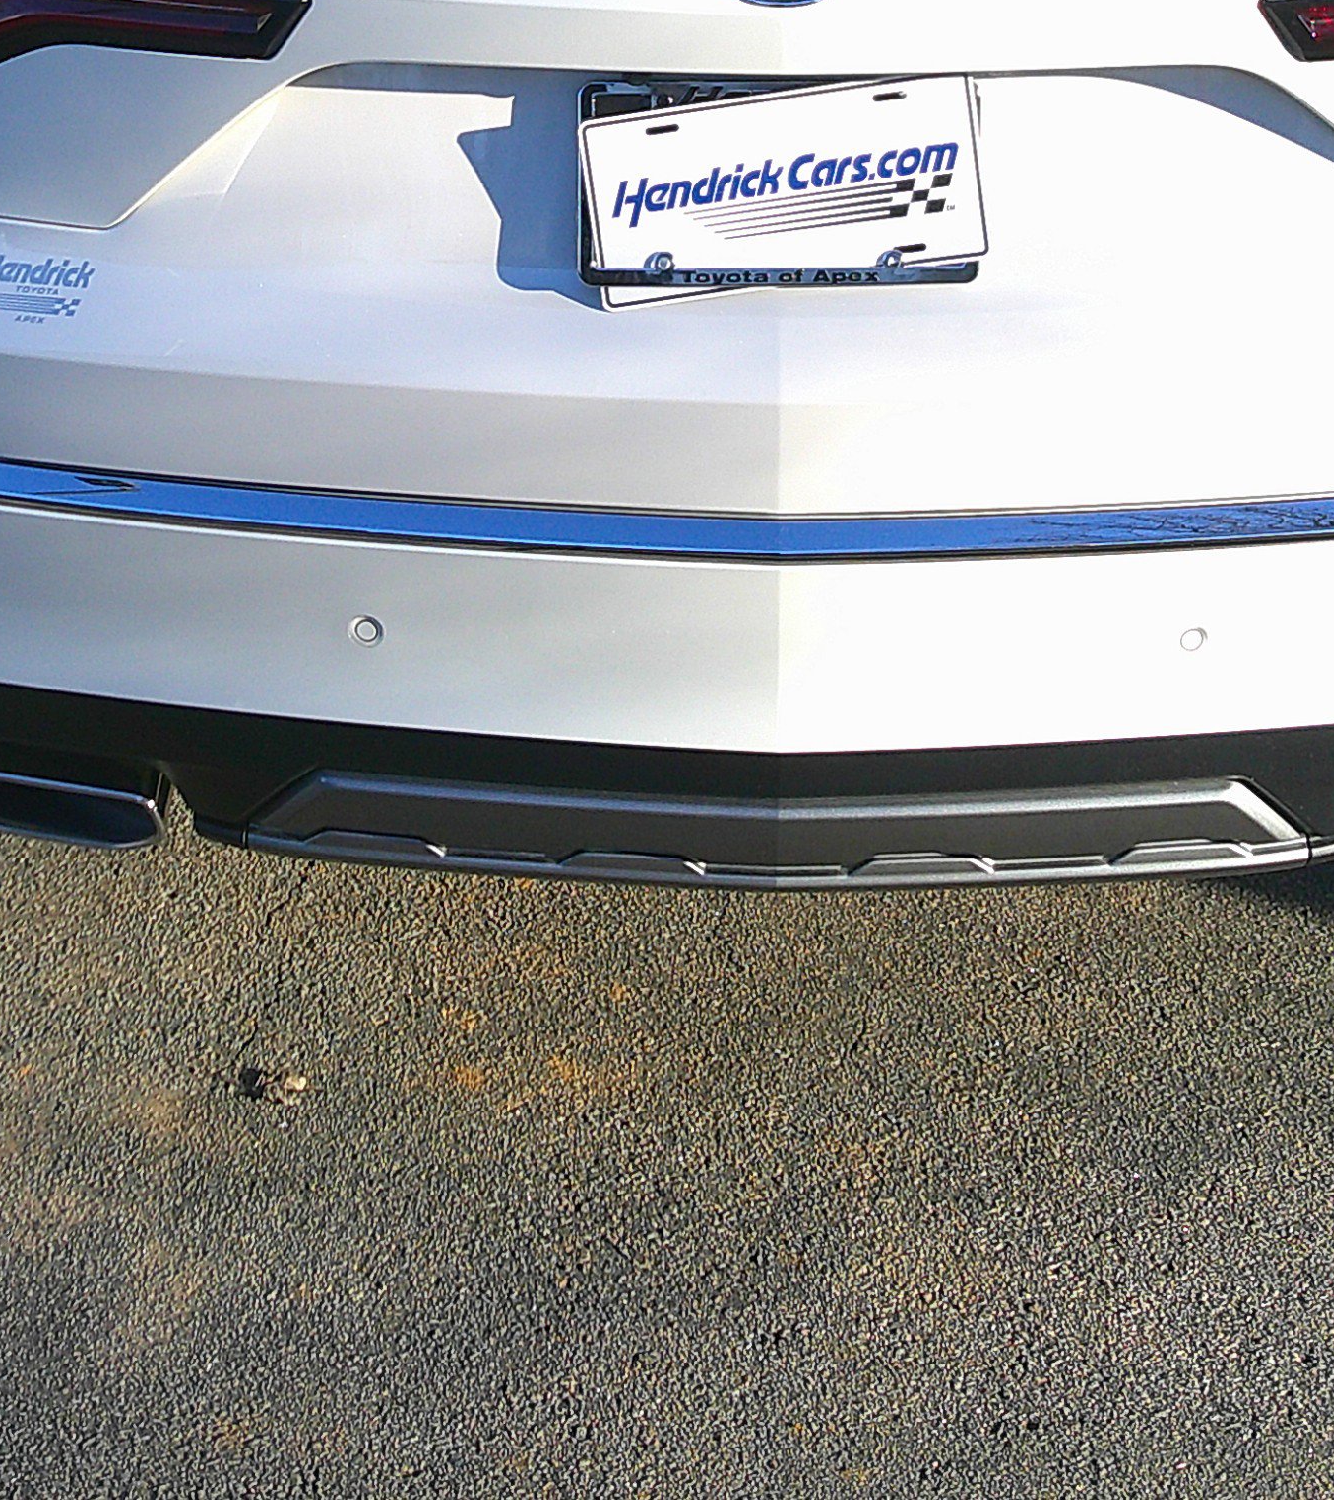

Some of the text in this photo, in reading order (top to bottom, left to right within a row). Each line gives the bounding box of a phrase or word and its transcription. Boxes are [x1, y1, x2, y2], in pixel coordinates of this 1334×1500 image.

[612, 142, 959, 228] Hendrick Cars.com
[678, 268, 879, 285] Toyota of Apex
[16, 285, 59, 295] TOYOTA
[15, 314, 45, 324] APEX
